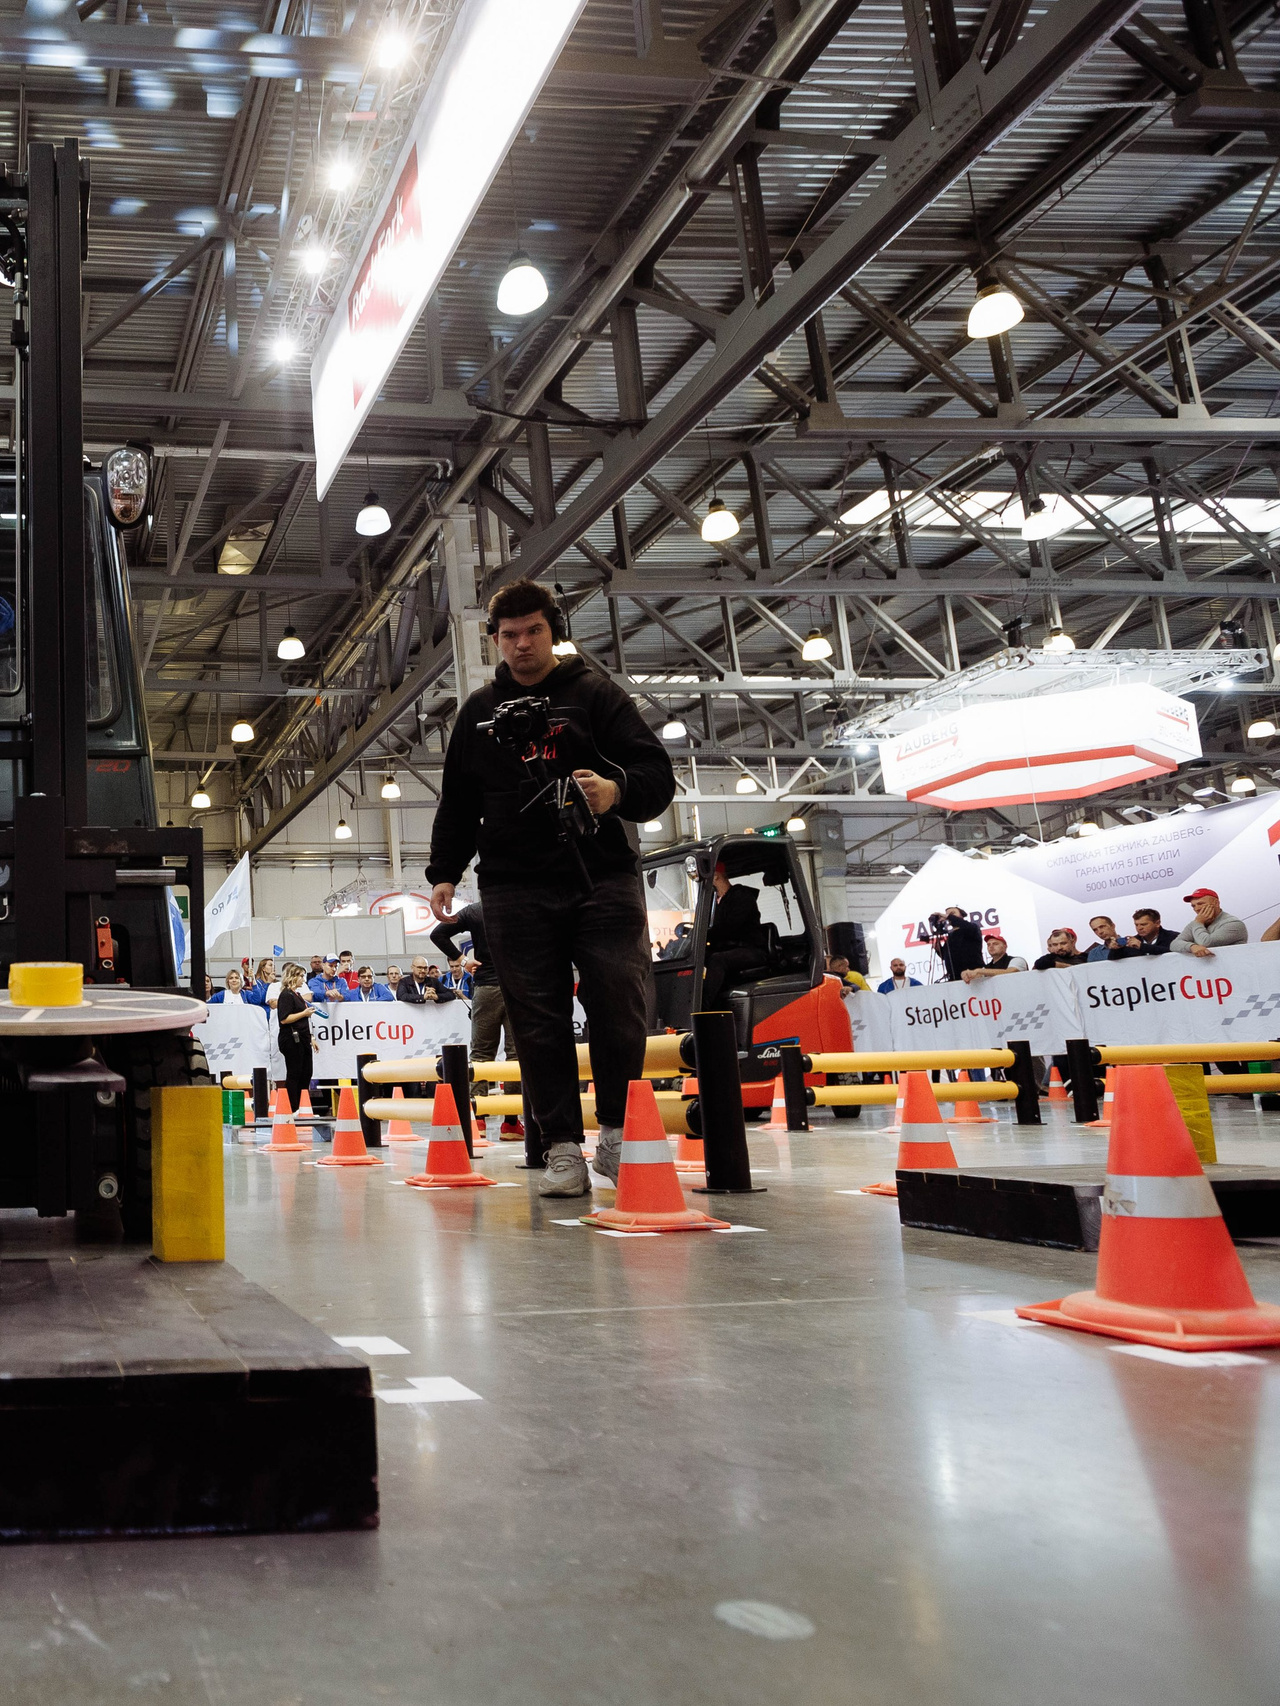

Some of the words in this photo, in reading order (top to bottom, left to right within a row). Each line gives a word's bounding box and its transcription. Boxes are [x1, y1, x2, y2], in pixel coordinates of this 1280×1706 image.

[896, 722, 959, 762] ZAUBERG
[1046, 850, 1102, 869] СКЛАДСКАЯ
[1104, 839, 1149, 855] ТЕХНИКА
[1152, 825, 1204, 846] ZAUBERG
[1075, 860, 1125, 878] ГАРАНТИЯ
[1127, 858, 1133, 868] 5
[1136, 853, 1155, 867] ЛЕТ
[1158, 849, 1181, 862] ИЛИ
[1086, 881, 1108, 892] 5000
[1109, 867, 1175, 888] МОТОЧАСОВ
[1087, 975, 1233, 1011] StaplerCup
[905, 996, 1002, 1028] StaplerCup
[757, 1046, 781, 1058] Lind
